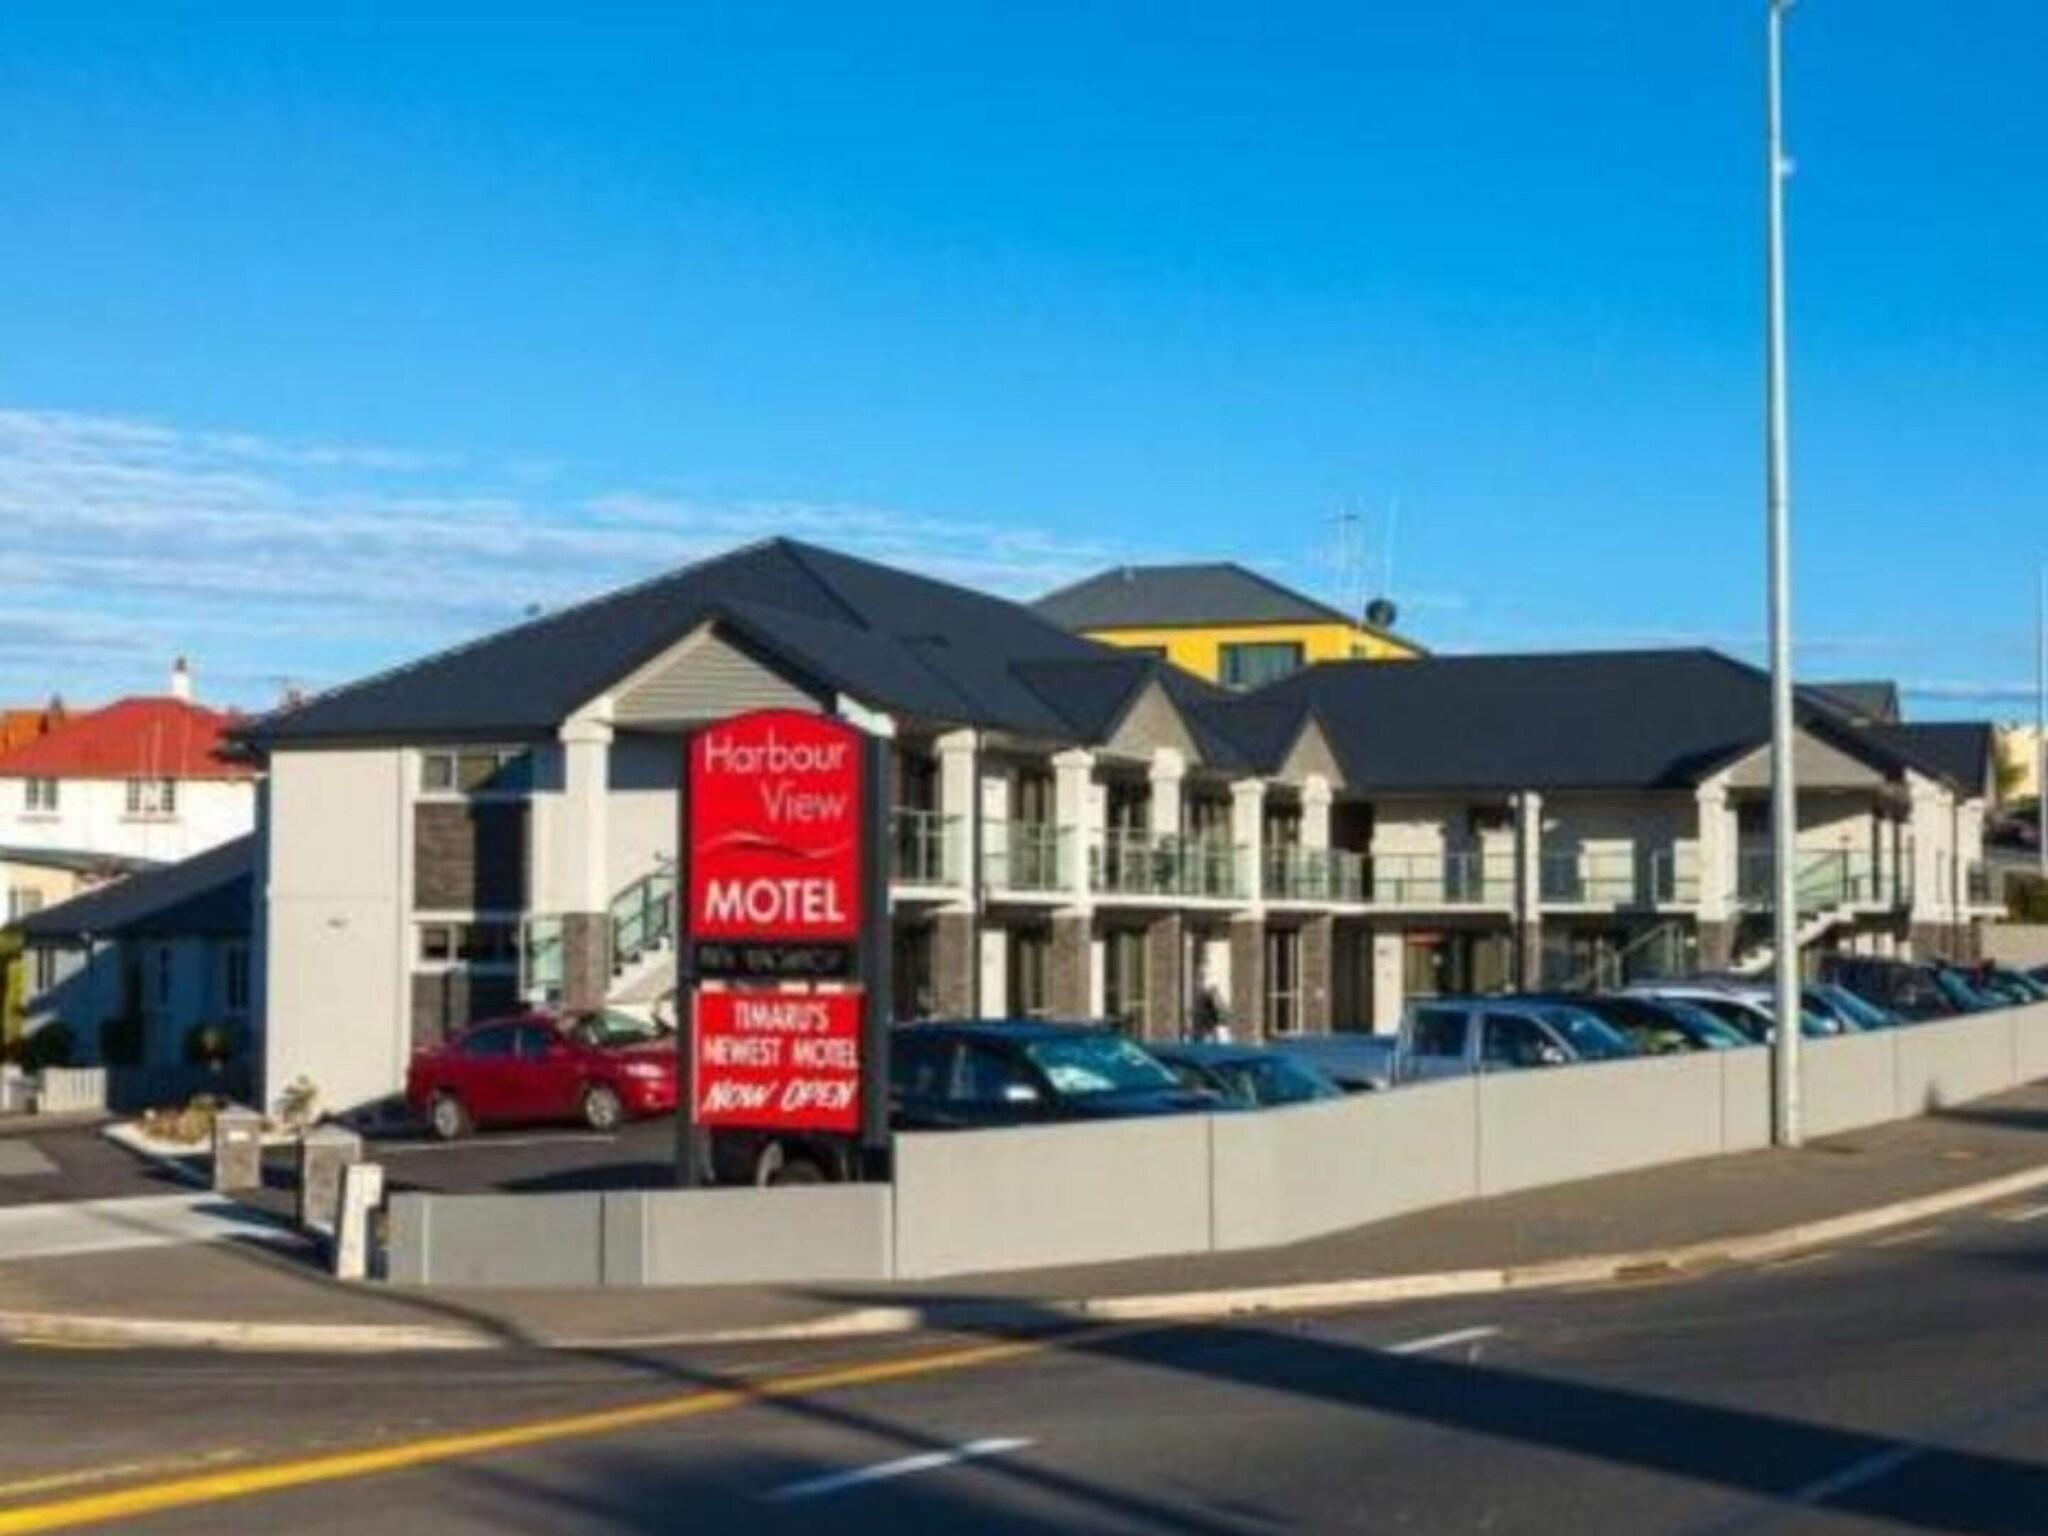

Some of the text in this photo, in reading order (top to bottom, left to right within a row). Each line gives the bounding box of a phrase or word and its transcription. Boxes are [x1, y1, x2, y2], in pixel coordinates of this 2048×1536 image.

[705, 728, 847, 773] Harbour
[760, 779, 848, 822] View
[705, 878, 846, 923] MOTEL
[704, 1035, 858, 1068] NEWEST MOTEL
[703, 1079, 858, 1111] NOW OPEN
